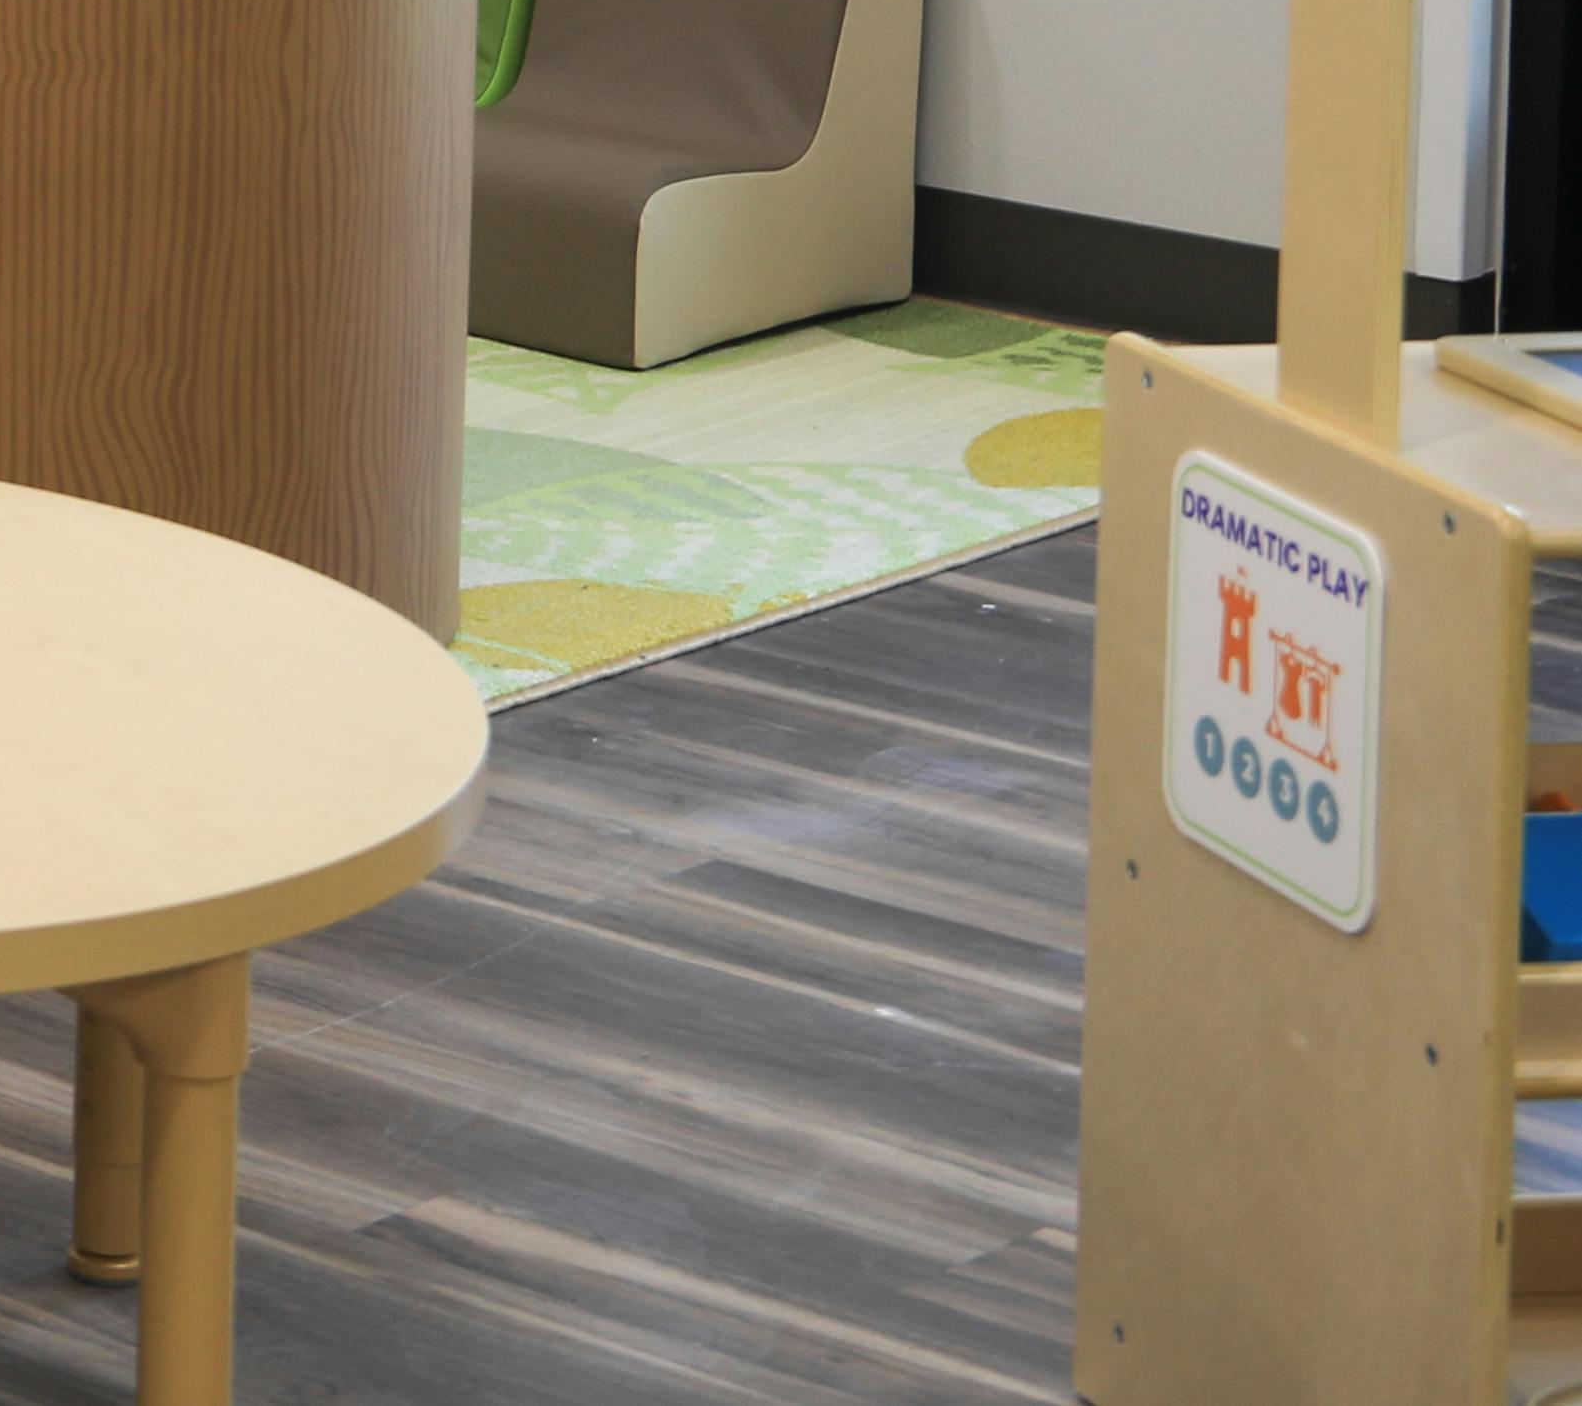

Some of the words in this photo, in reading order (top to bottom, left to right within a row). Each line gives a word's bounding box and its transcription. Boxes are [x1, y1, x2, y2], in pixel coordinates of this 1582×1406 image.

[1181, 486, 1300, 575] DRAMATIC
[1307, 551, 1370, 609] PLAY
[1205, 732, 1215, 759] 1
[1241, 754, 1255, 784] 2
[1277, 773, 1292, 802] 3
[1316, 796, 1332, 826] 4
